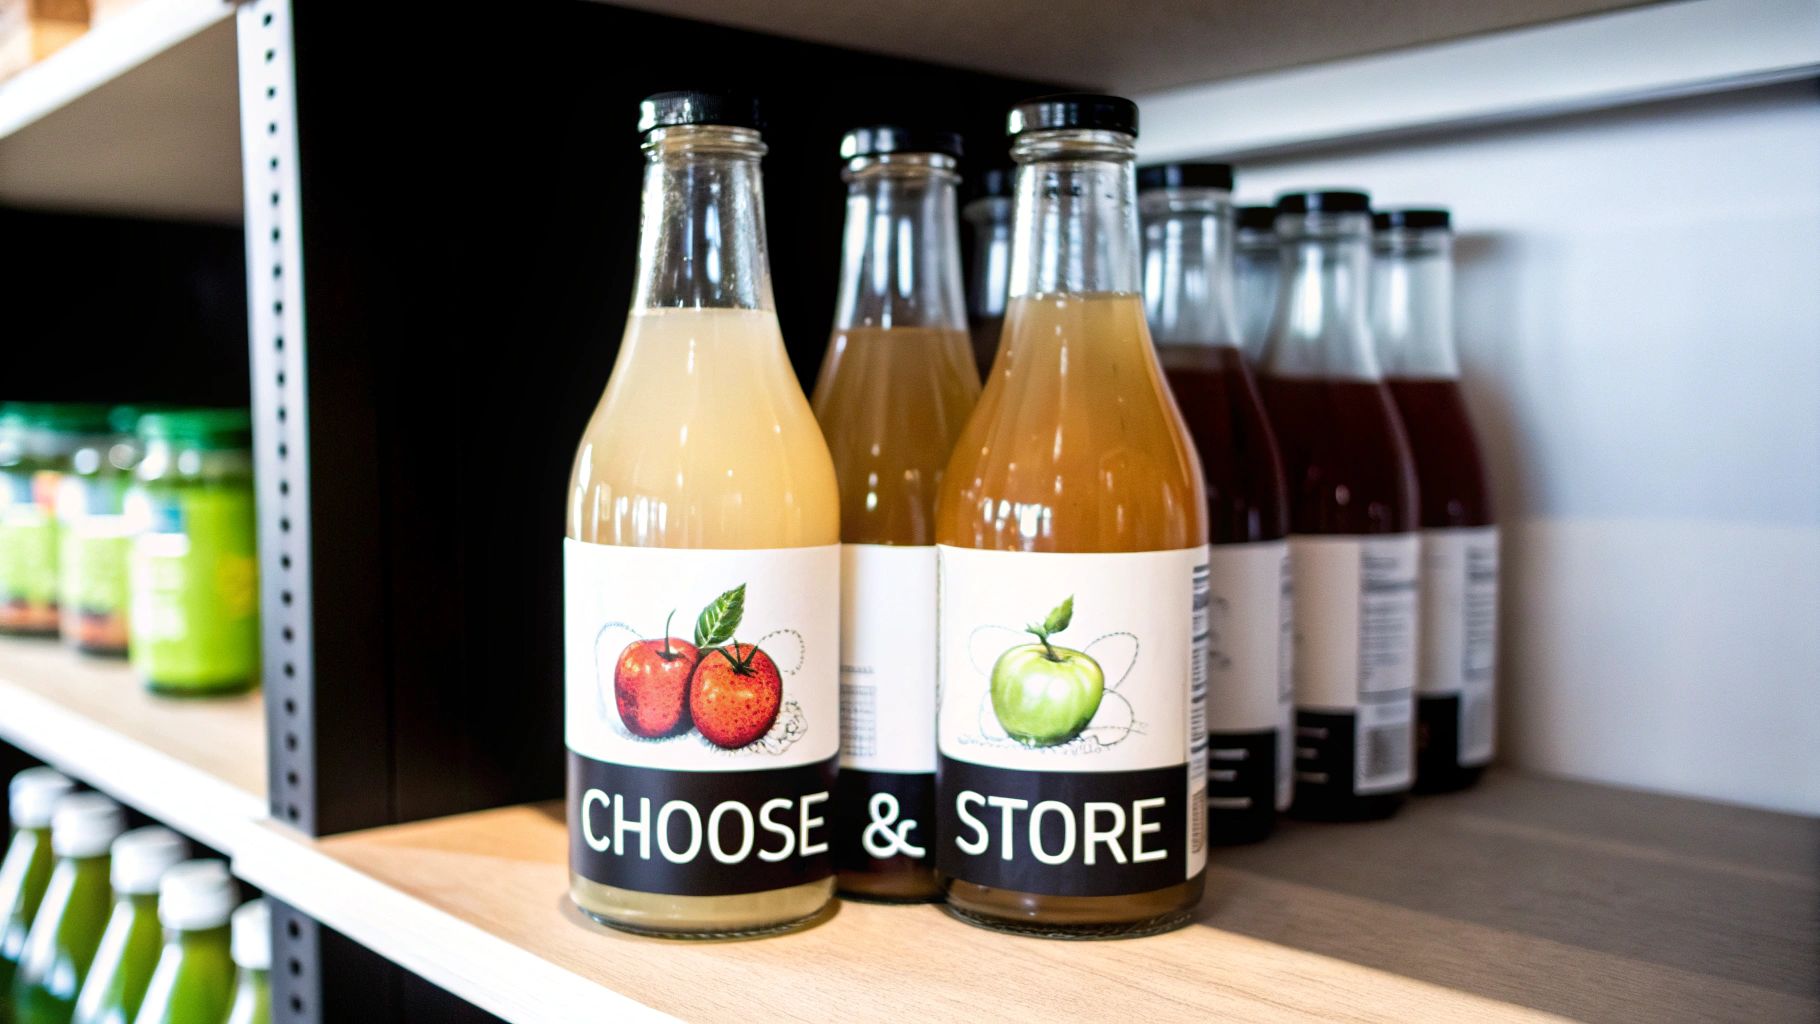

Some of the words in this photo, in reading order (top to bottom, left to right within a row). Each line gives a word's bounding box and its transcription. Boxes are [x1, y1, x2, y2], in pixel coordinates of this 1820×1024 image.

[580, 788, 831, 865] CHOOSE
[861, 791, 927, 860] &
[954, 789, 1169, 867] STORE
